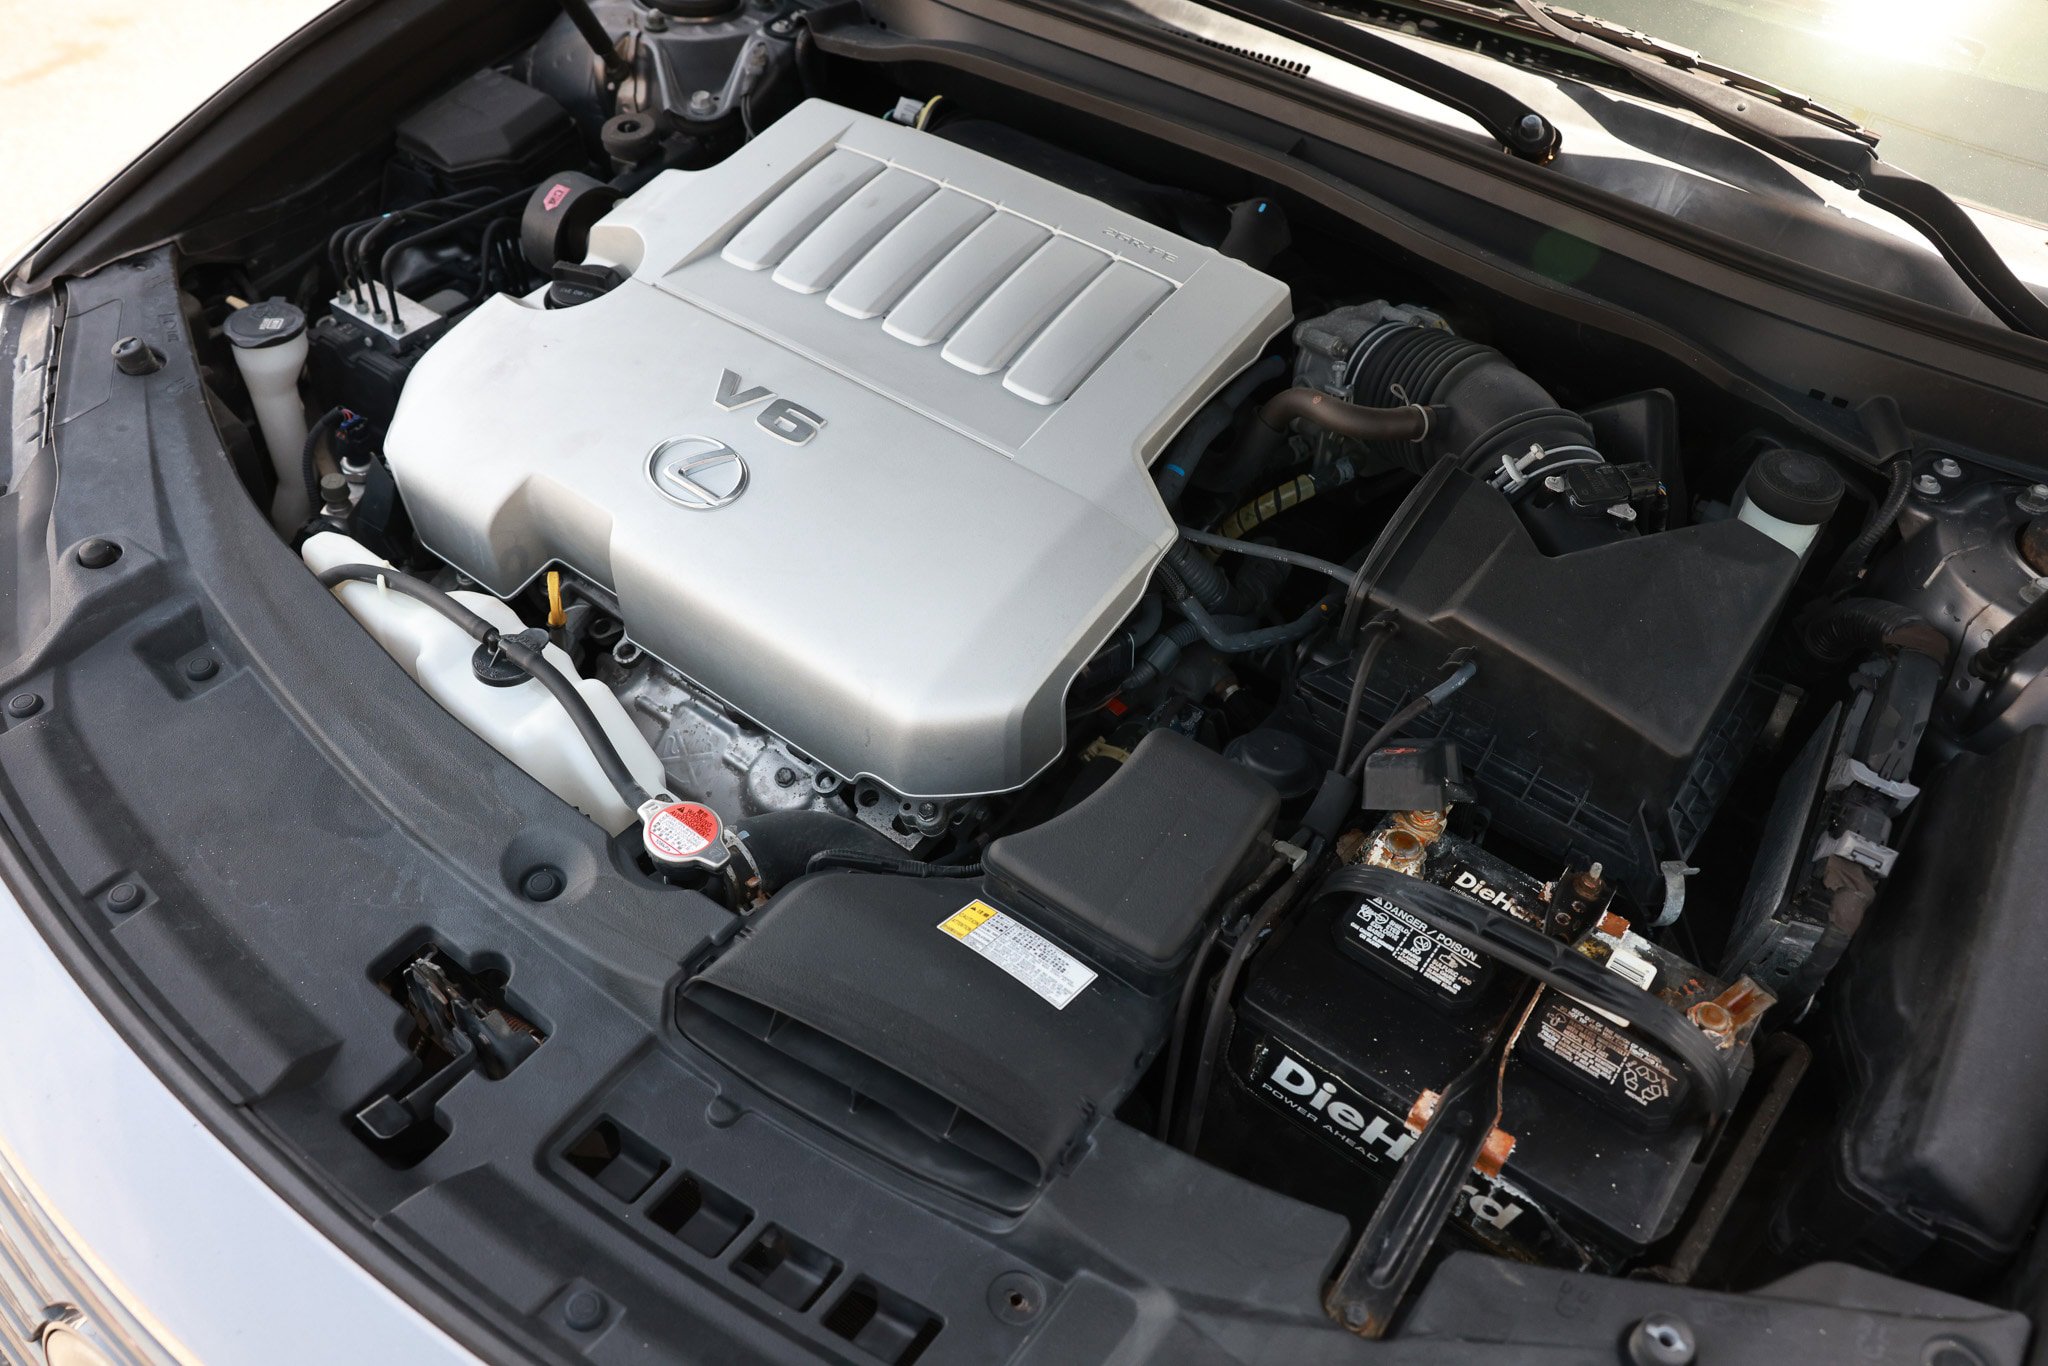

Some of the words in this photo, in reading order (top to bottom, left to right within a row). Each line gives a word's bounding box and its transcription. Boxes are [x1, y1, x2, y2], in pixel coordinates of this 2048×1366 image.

[713, 367, 828, 447] V6
[1383, 901, 1429, 932] DANGER
[1436, 932, 1478, 962] POISON
[1410, 947, 1421, 955] NO
[1262, 1083, 1318, 1122] POWER
[1322, 1124, 1380, 1163] AHEAD
